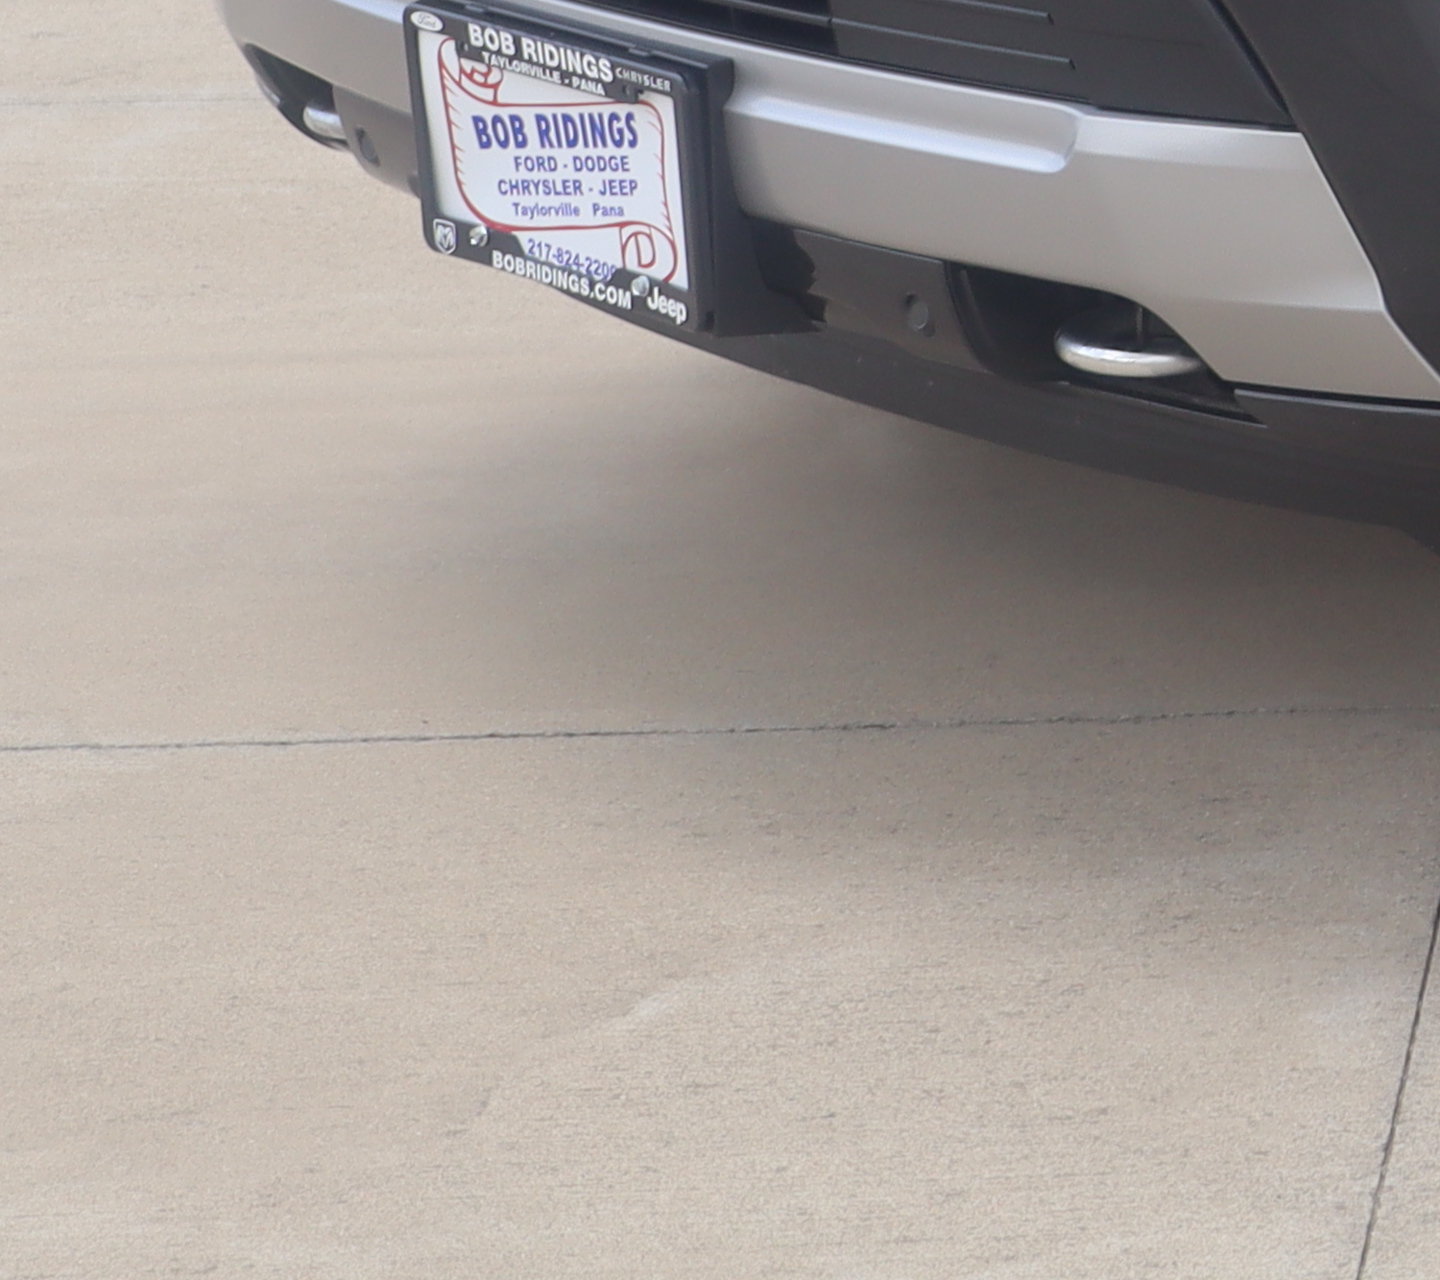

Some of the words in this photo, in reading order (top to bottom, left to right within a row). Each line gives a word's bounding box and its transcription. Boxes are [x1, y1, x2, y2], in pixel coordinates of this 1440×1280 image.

[467, 23, 516, 57] BOB
[520, 37, 614, 83] RIDINGS
[481, 51, 562, 85] TAYLORVILLE
[571, 74, 606, 96] PANA
[614, 66, 672, 92] CHRYSLER
[471, 113, 528, 149] BOB
[534, 111, 639, 149] RIDINGS
[513, 155, 558, 172] FORD
[572, 155, 630, 172] DODGE
[497, 178, 584, 196] CHRYSLER
[598, 178, 638, 196] JEEP
[512, 202, 581, 220] Taylorville
[592, 202, 625, 217] Pana
[491, 249, 633, 310] BOBRIDINGS.COM
[646, 286, 687, 325] Jeep
